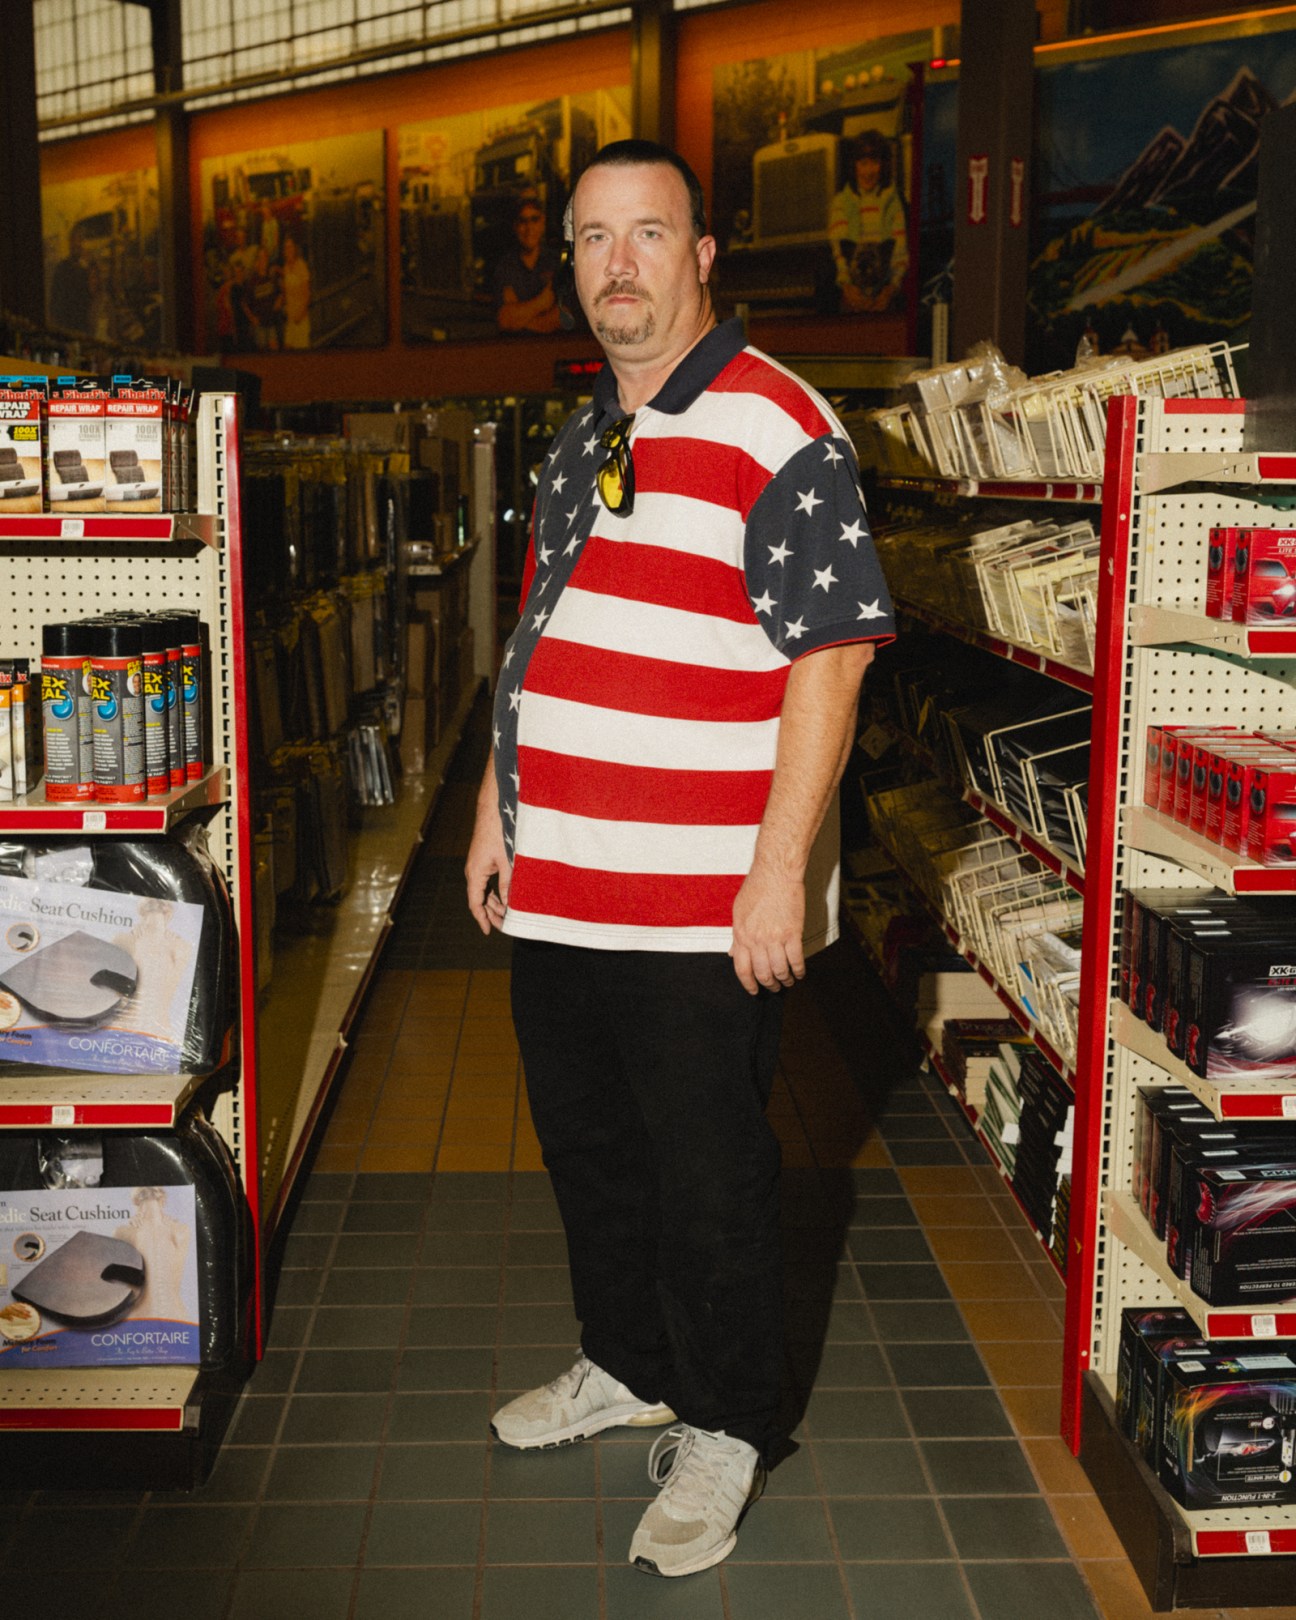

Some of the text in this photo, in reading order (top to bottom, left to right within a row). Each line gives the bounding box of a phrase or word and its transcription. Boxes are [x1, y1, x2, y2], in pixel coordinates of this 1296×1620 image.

[63, 389, 110, 400] FiberFix
[118, 388, 166, 400] FiberFix
[50, 403, 101, 413] REPAIR WRAP
[107, 403, 159, 413] REPAIR WRAP
[13, 426, 38, 435] 100X
[79, 424, 101, 434] 100X
[136, 424, 158, 434] 100X
[42, 687, 66, 700] AL
[30, 897, 63, 916] Seat
[66, 903, 133, 928] Cushion
[68, 1036, 168, 1061] CONFORTAIRE
[30, 1207, 62, 1222] Seat
[65, 1204, 130, 1221] Cushion
[91, 1332, 190, 1346] CONFORTAIRE
[1221, 1493, 1257, 1501] FUNCTION
